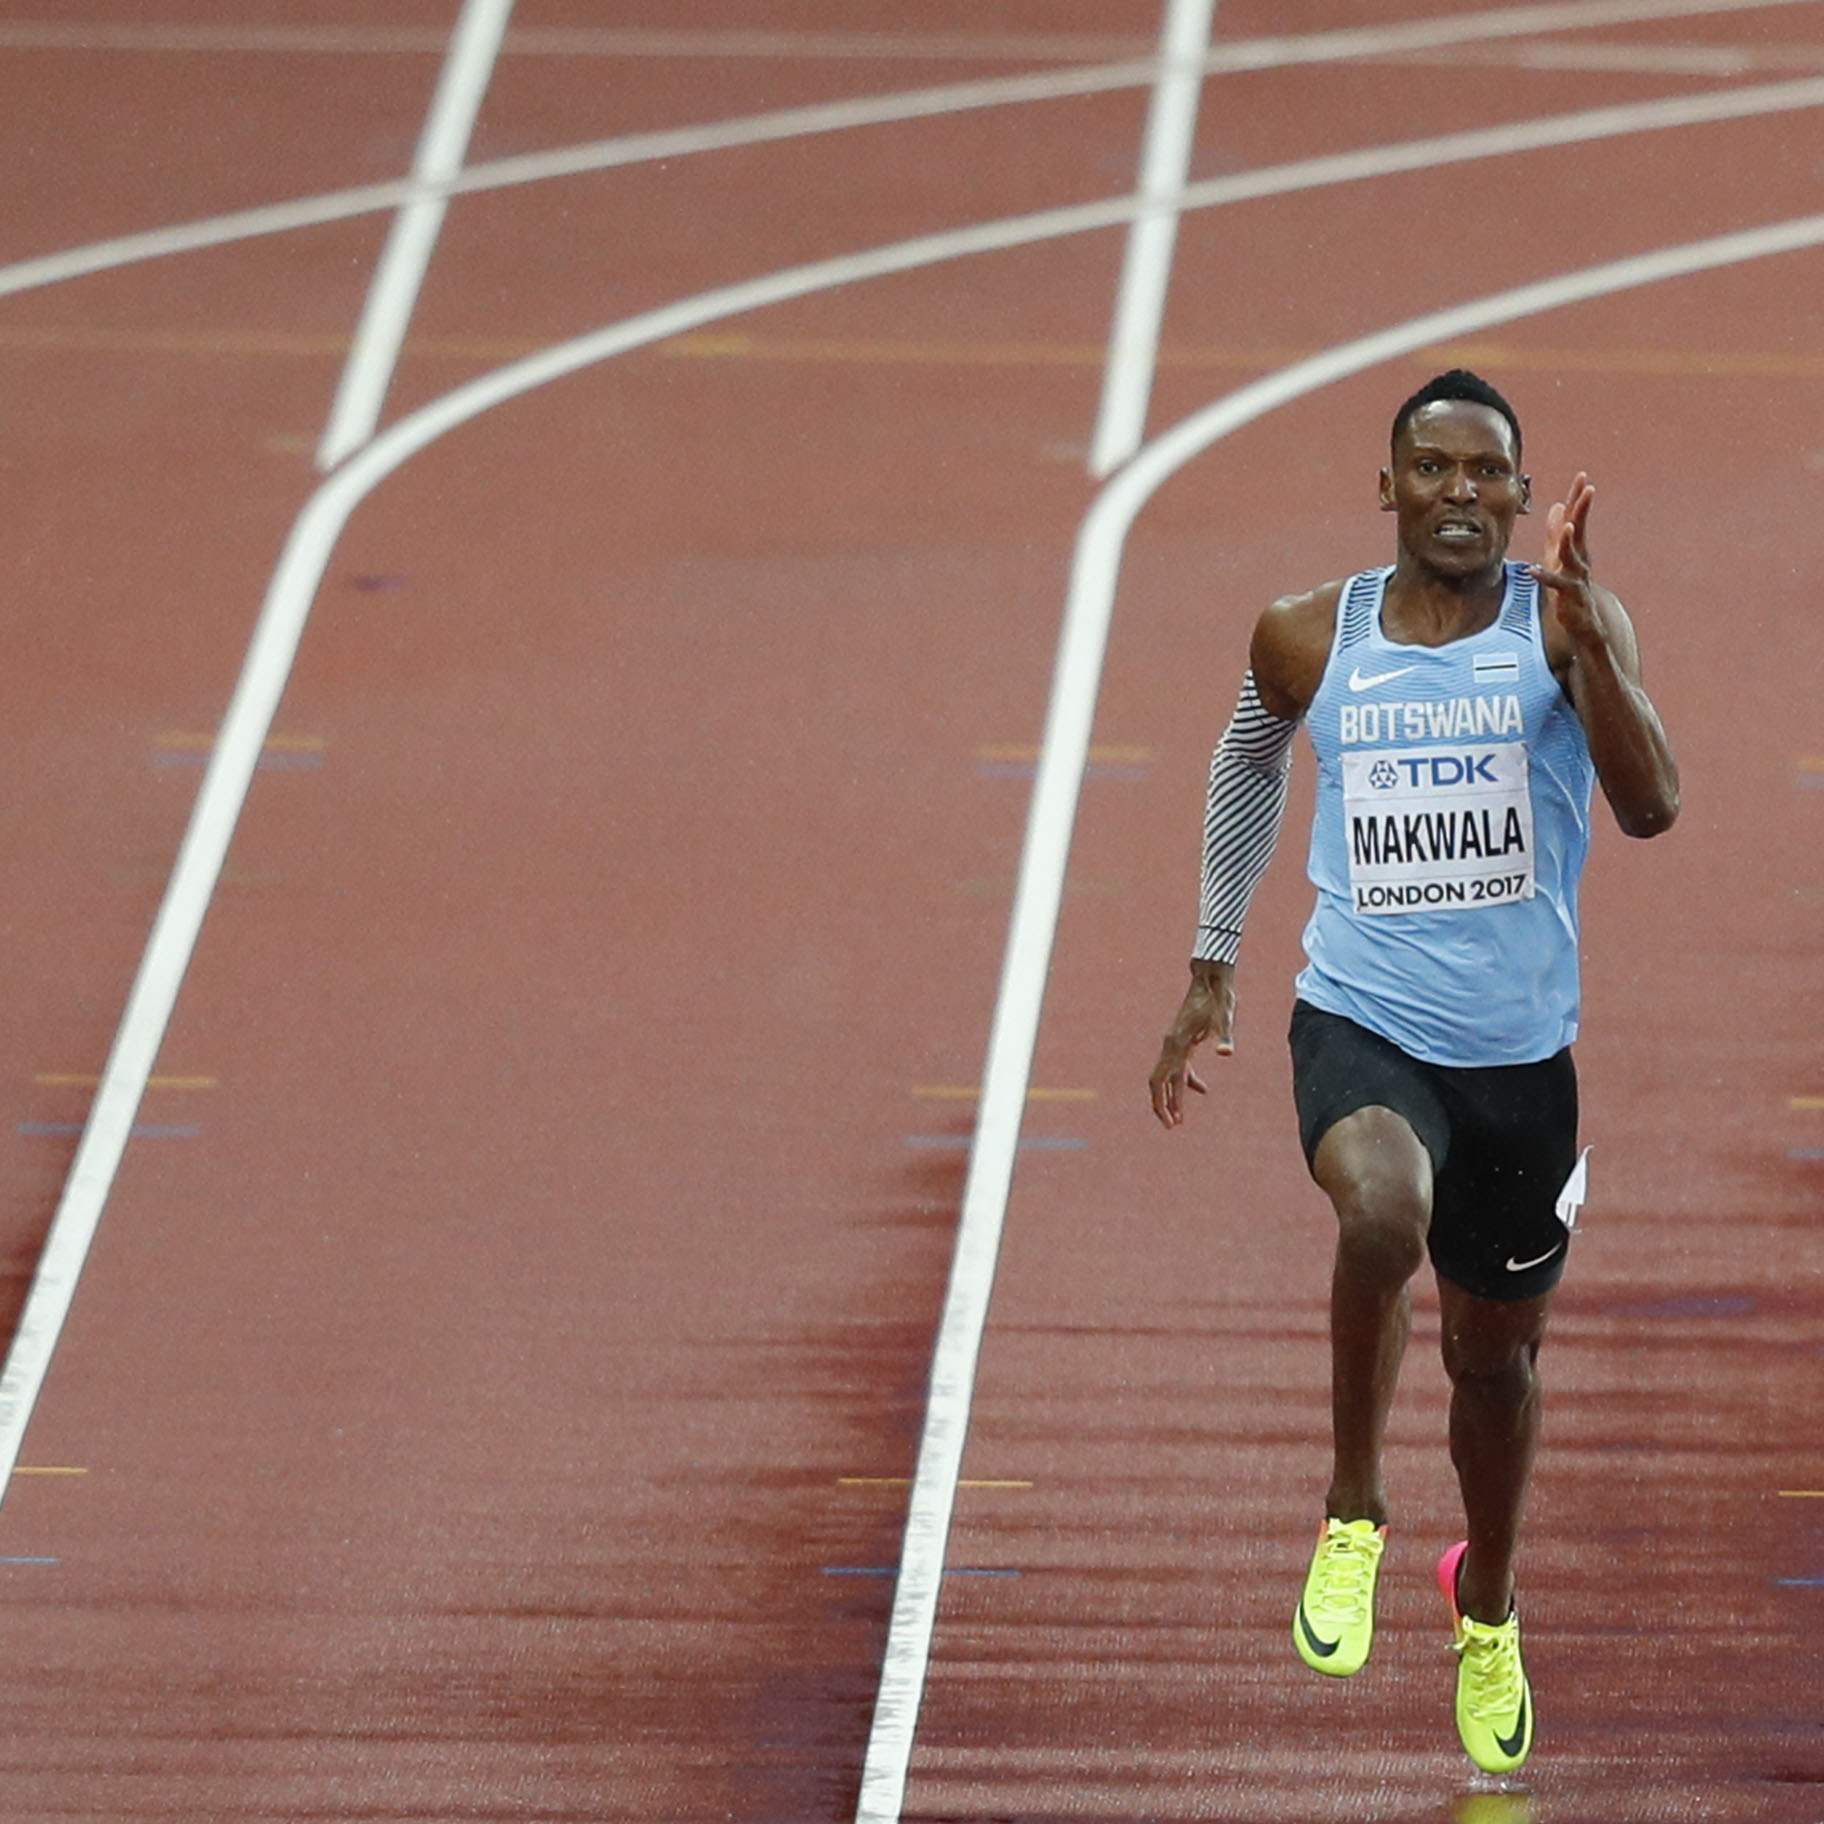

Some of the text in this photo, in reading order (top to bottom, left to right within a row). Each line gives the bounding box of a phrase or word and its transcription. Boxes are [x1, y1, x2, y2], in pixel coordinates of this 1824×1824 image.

[1341, 695, 1523, 743] BOTSWANA
[1397, 754, 1498, 787] TDK
[1353, 807, 1525, 865] MAKWALA
[1357, 874, 1527, 907] LONDON 2017
